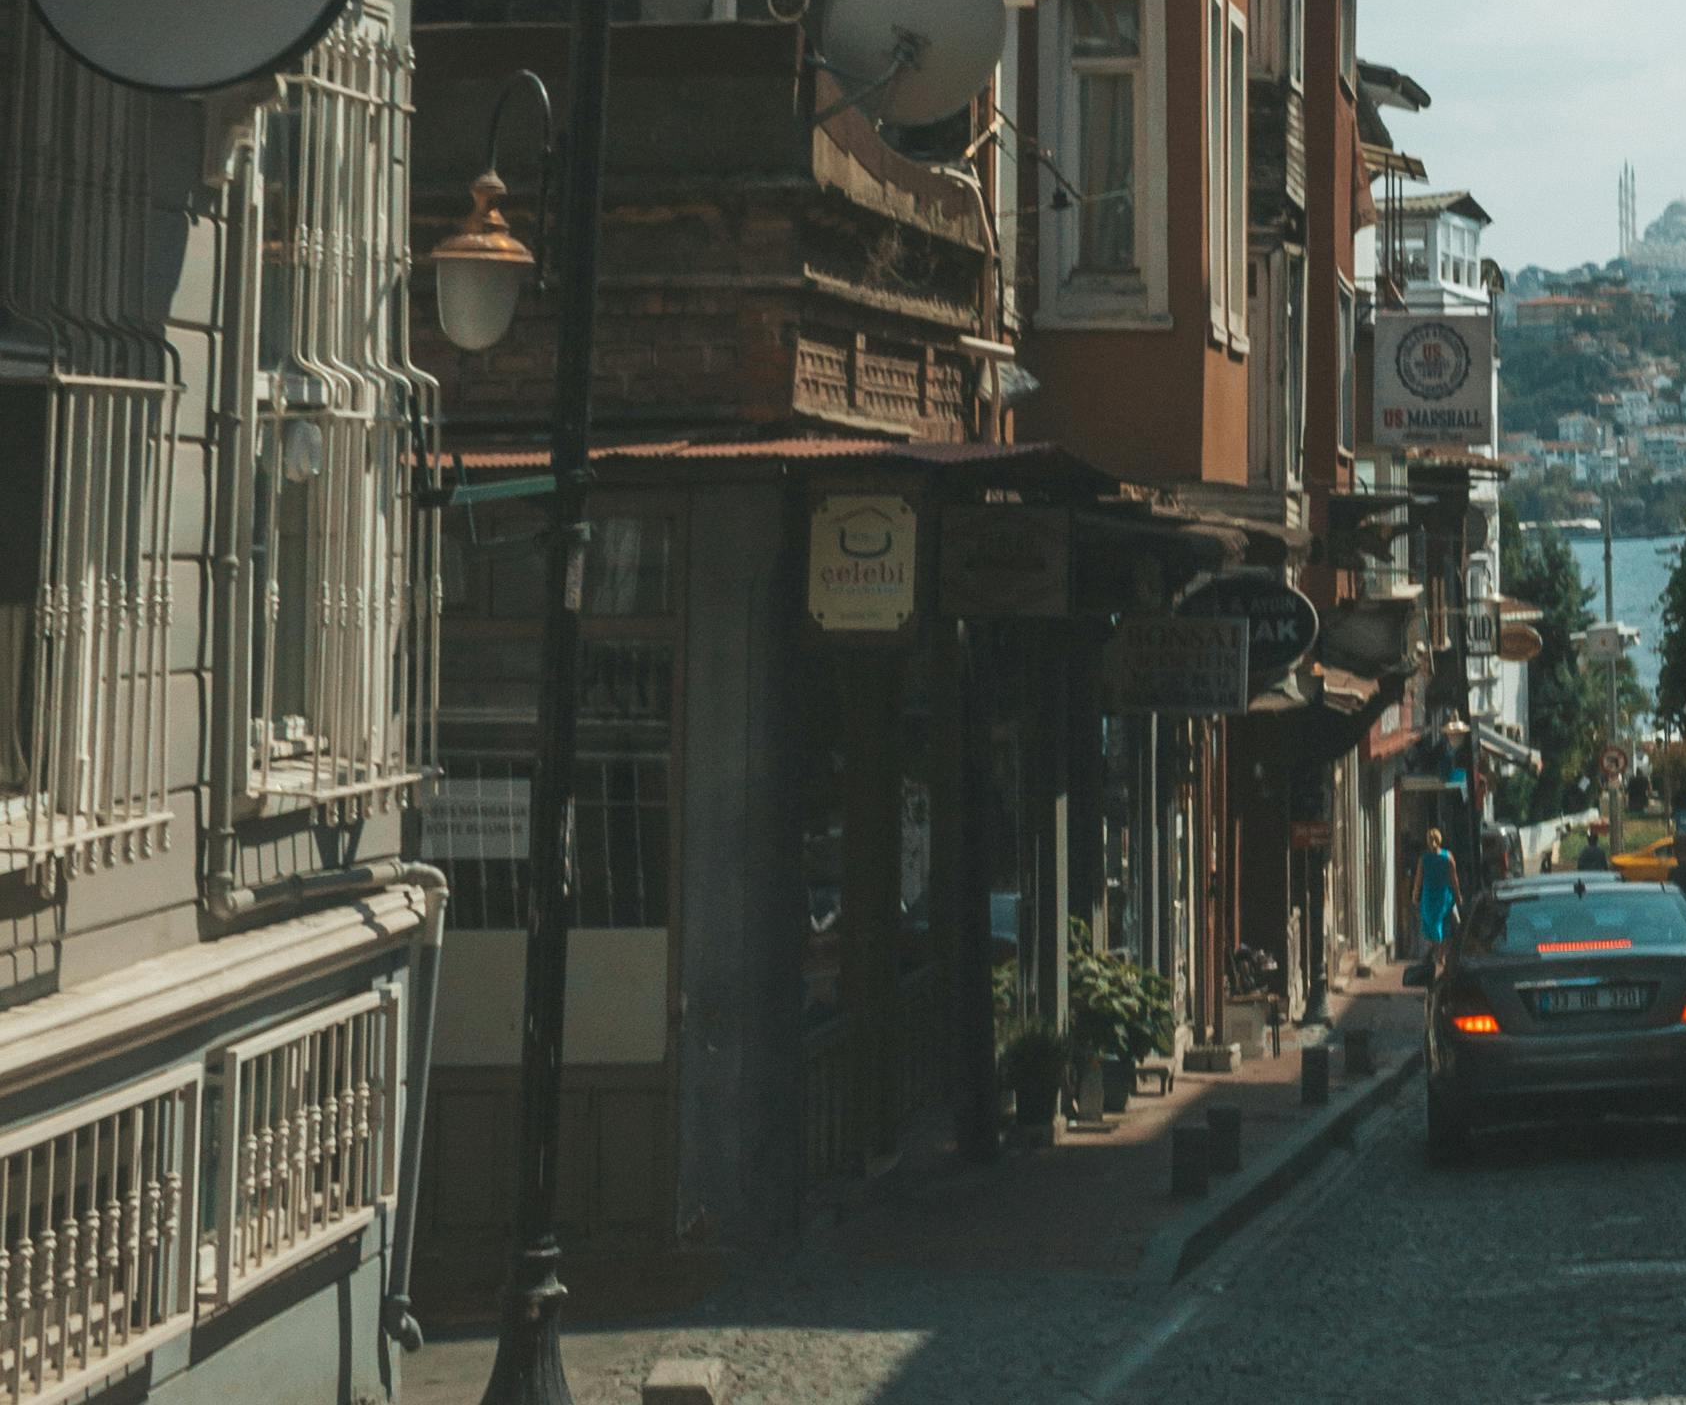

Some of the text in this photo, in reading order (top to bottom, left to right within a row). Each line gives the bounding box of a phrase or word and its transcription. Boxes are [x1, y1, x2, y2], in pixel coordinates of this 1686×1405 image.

[1384, 409, 1482, 429] US MARSHALL
[821, 562, 904, 591] çelebi
[1127, 625, 1239, 648] BONSAI
